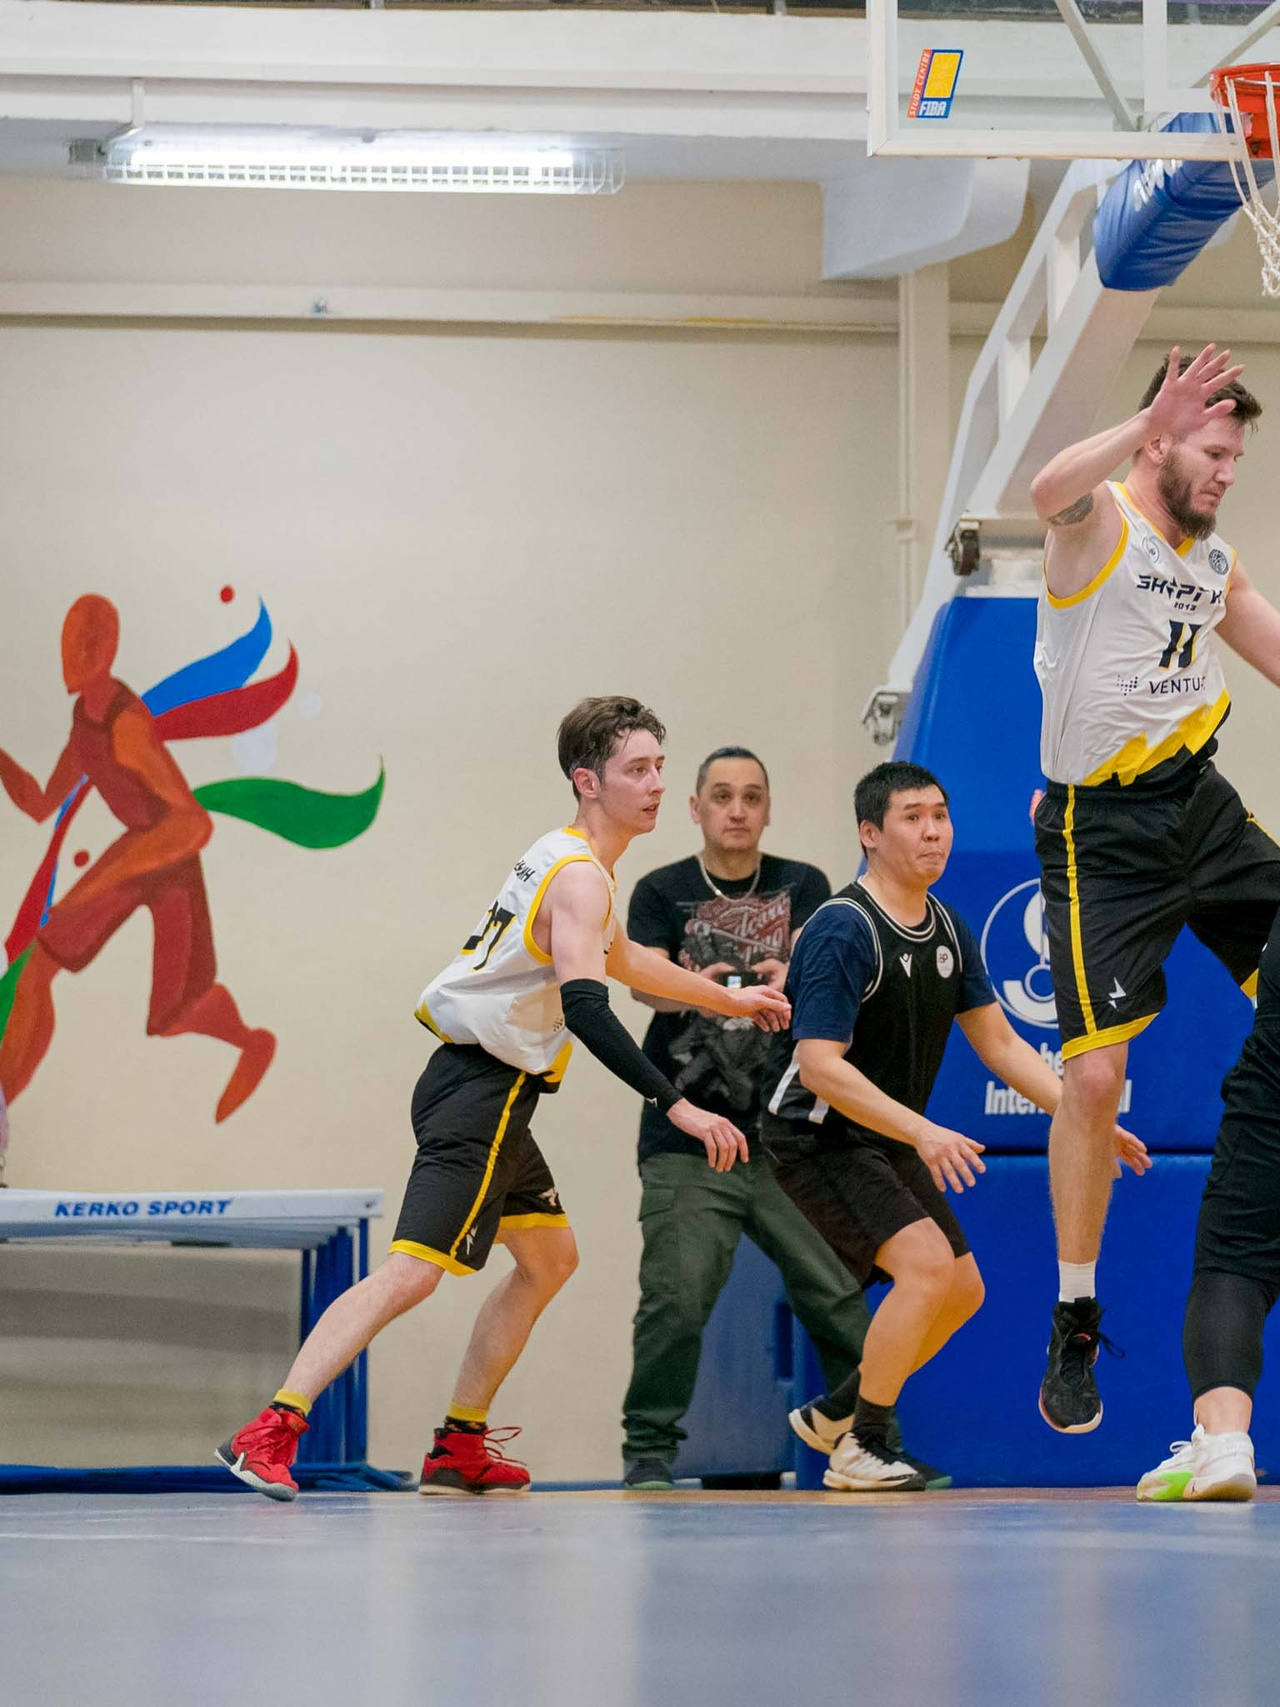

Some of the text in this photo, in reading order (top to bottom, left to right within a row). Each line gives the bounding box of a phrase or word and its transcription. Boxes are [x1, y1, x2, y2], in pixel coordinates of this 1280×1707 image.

[919, 101, 948, 116] FIBA
[1158, 619, 1203, 670] 11
[54, 1200, 233, 1217] KERKO SPORT
